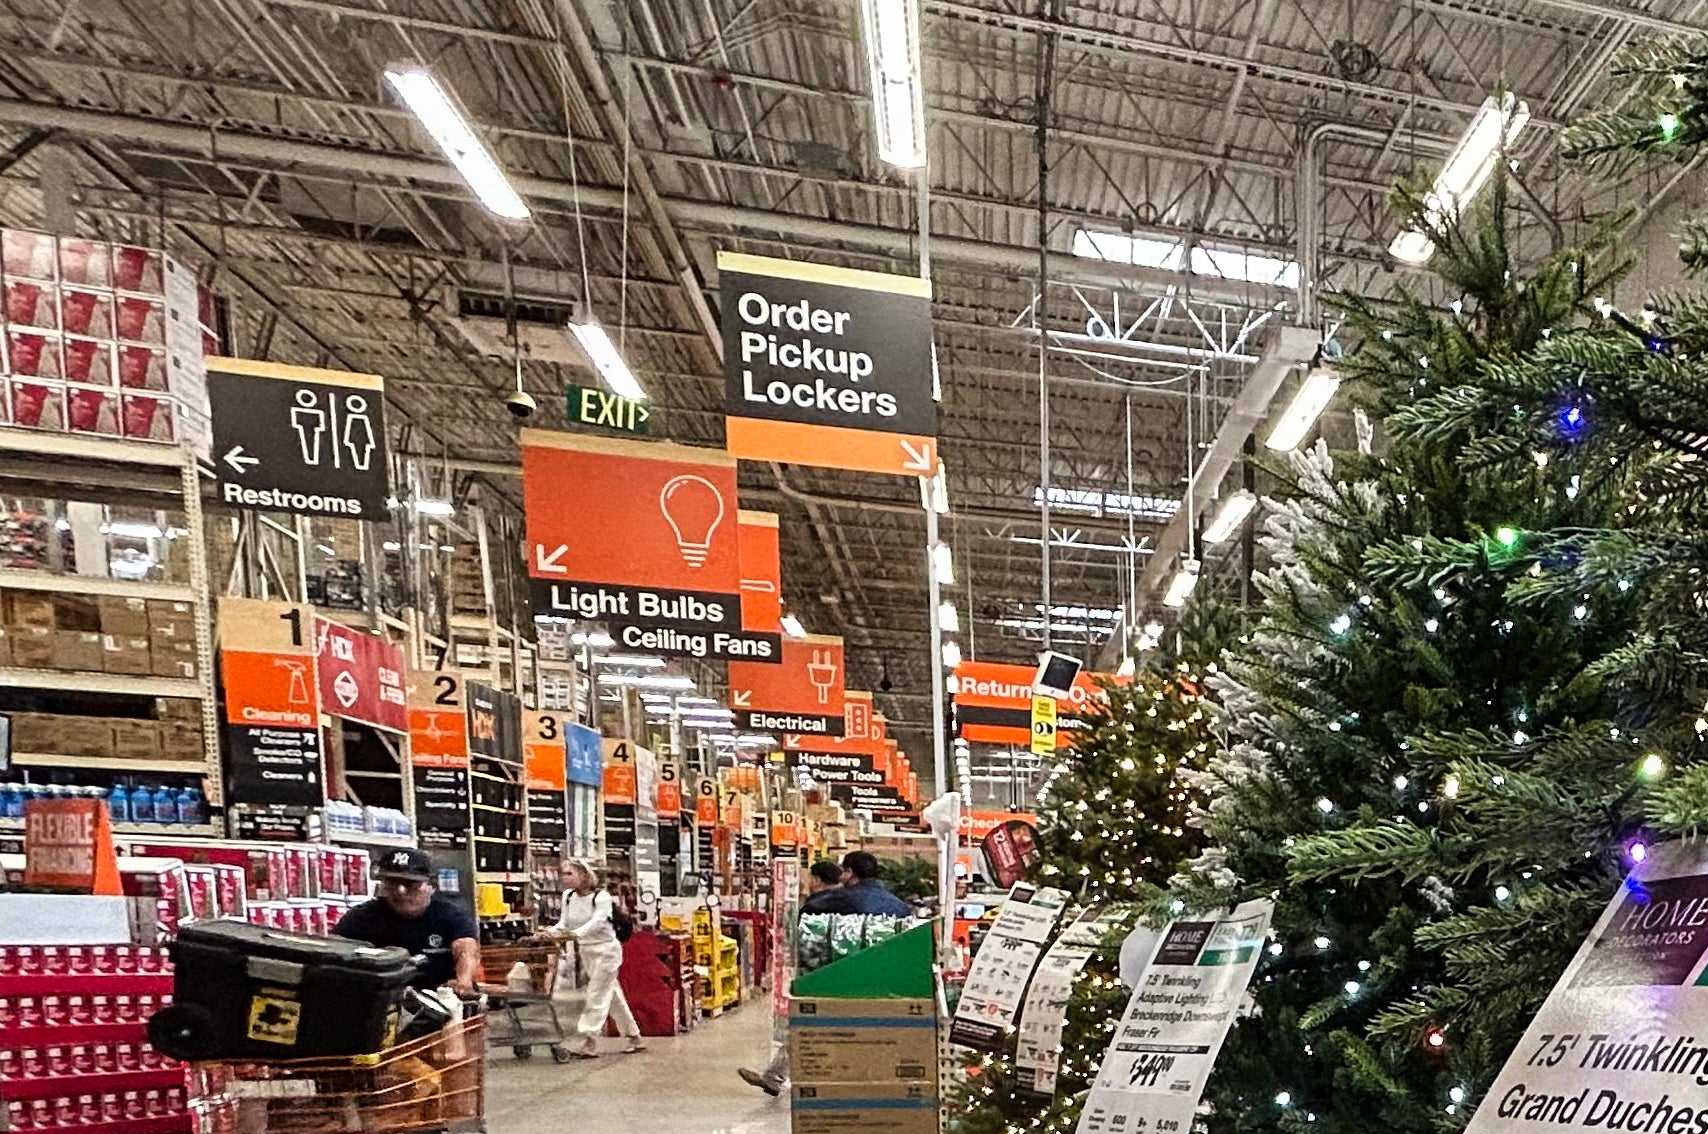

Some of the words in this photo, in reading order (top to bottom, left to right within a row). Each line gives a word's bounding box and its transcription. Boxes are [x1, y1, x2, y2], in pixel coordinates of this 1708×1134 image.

[737, 291, 851, 336] Order
[740, 331, 874, 382] Pickup
[580, 390, 637, 428] EXIT
[743, 370, 898, 418] Lockers
[223, 483, 363, 515] Restrooms
[551, 586, 629, 622] Light
[637, 592, 725, 624] Bulbs
[280, 608, 302, 646] 1
[622, 625, 707, 659] Ceiling
[713, 631, 773, 658] Fans
[434, 676, 459, 706] 2
[961, 677, 1033, 699] Return
[242, 706, 312, 726] Cleaning
[538, 716, 557, 740] 3
[750, 713, 827, 733] Electrical
[613, 743, 629, 763] 4
[798, 752, 861, 768] Hardware
[662, 764, 675, 782] 5
[700, 780, 713, 796] 6
[813, 769, 850, 781] Power
[852, 769, 883, 783] Tools
[726, 792, 737, 806] 7
[30, 812, 95, 845] FLEXIBLE
[778, 812, 793, 825] 10
[1525, 1033, 1580, 1069] 7.5'
[1497, 1083, 1589, 1124] Grand
